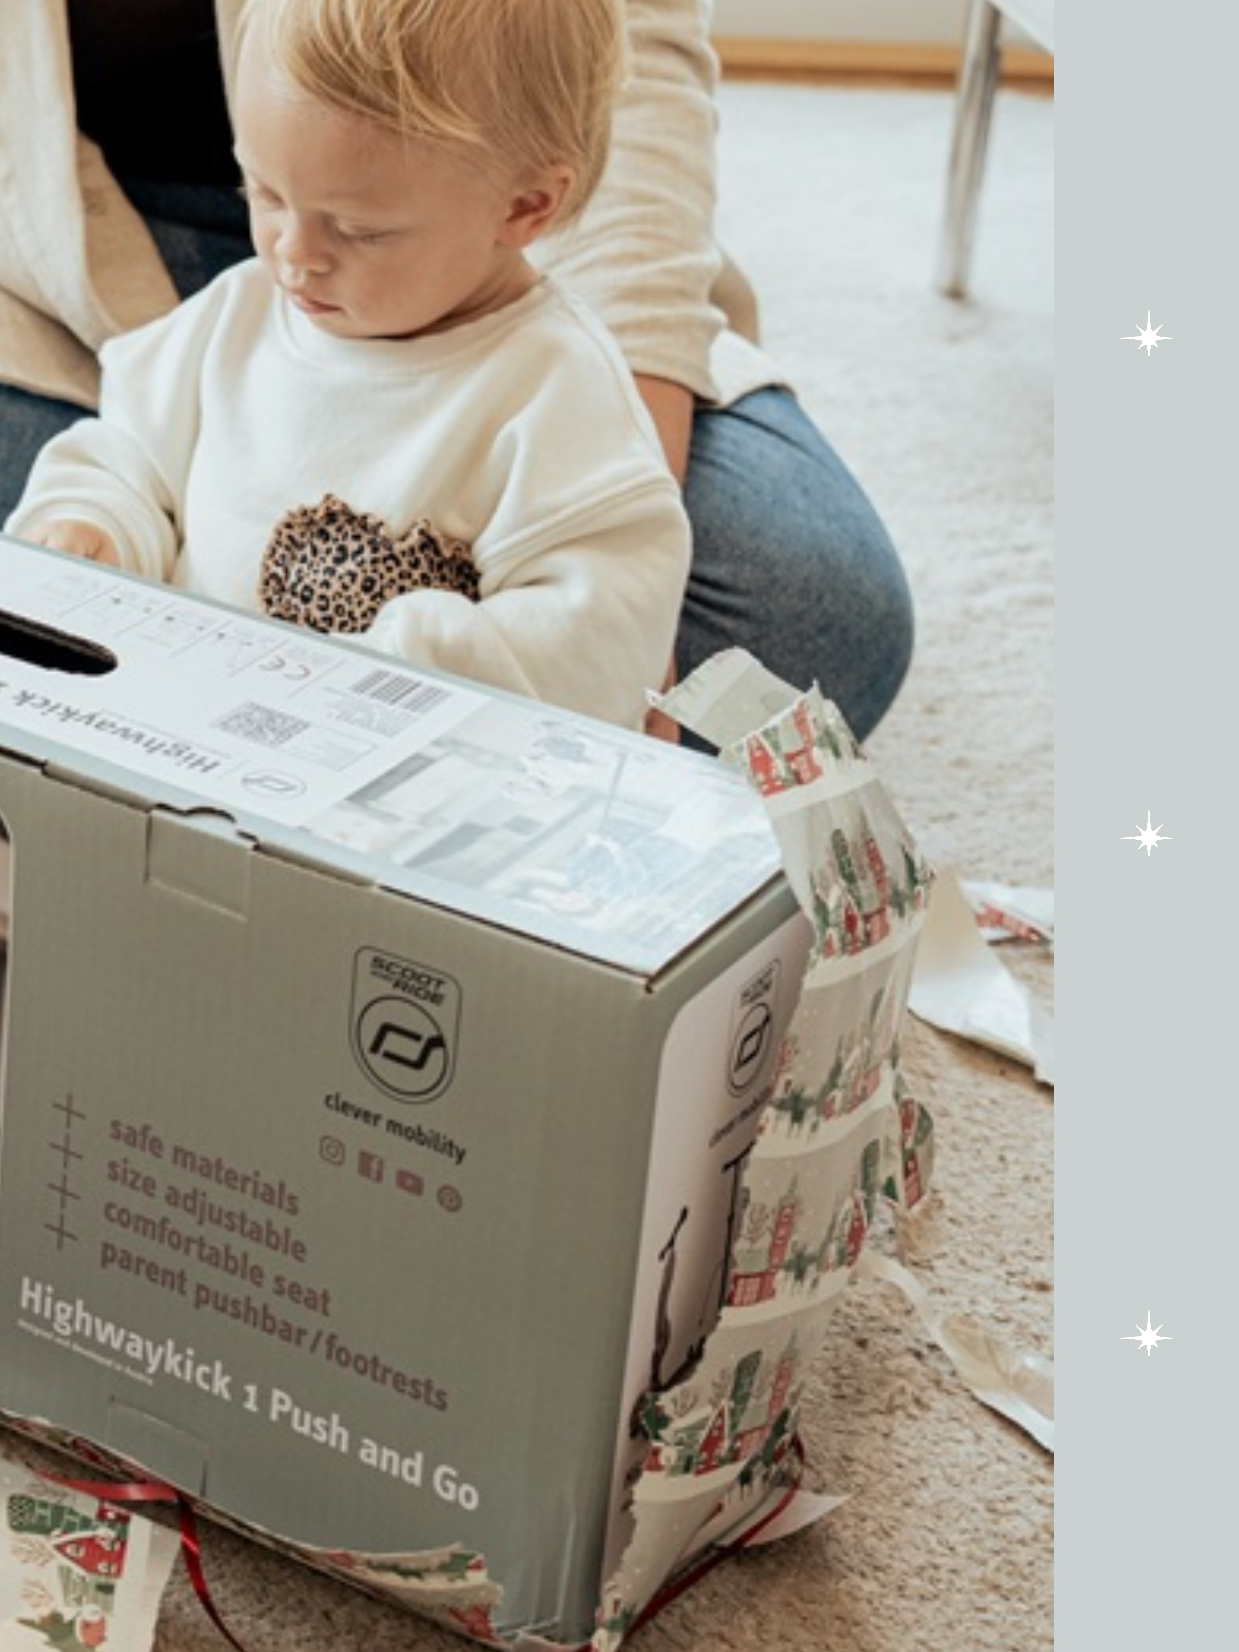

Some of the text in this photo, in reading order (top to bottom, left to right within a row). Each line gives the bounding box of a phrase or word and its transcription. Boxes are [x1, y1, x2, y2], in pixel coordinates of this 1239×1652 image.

[14, 686, 219, 773] Highwaykick
[370, 956, 446, 990] SCOOT
[391, 980, 445, 1007] RIDE
[110, 1117, 300, 1216] safe materials
[324, 1092, 467, 1165] clever mobility
[106, 1158, 308, 1263] size adjustable
[100, 1241, 187, 1296] parent
[103, 1201, 331, 1318] comfortable seat
[20, 1277, 232, 1402] Highwaykick
[243, 1383, 259, 1413] 1
[269, 1391, 350, 1453] Push
[359, 1437, 422, 1487] and
[432, 1465, 480, 1512] Go
